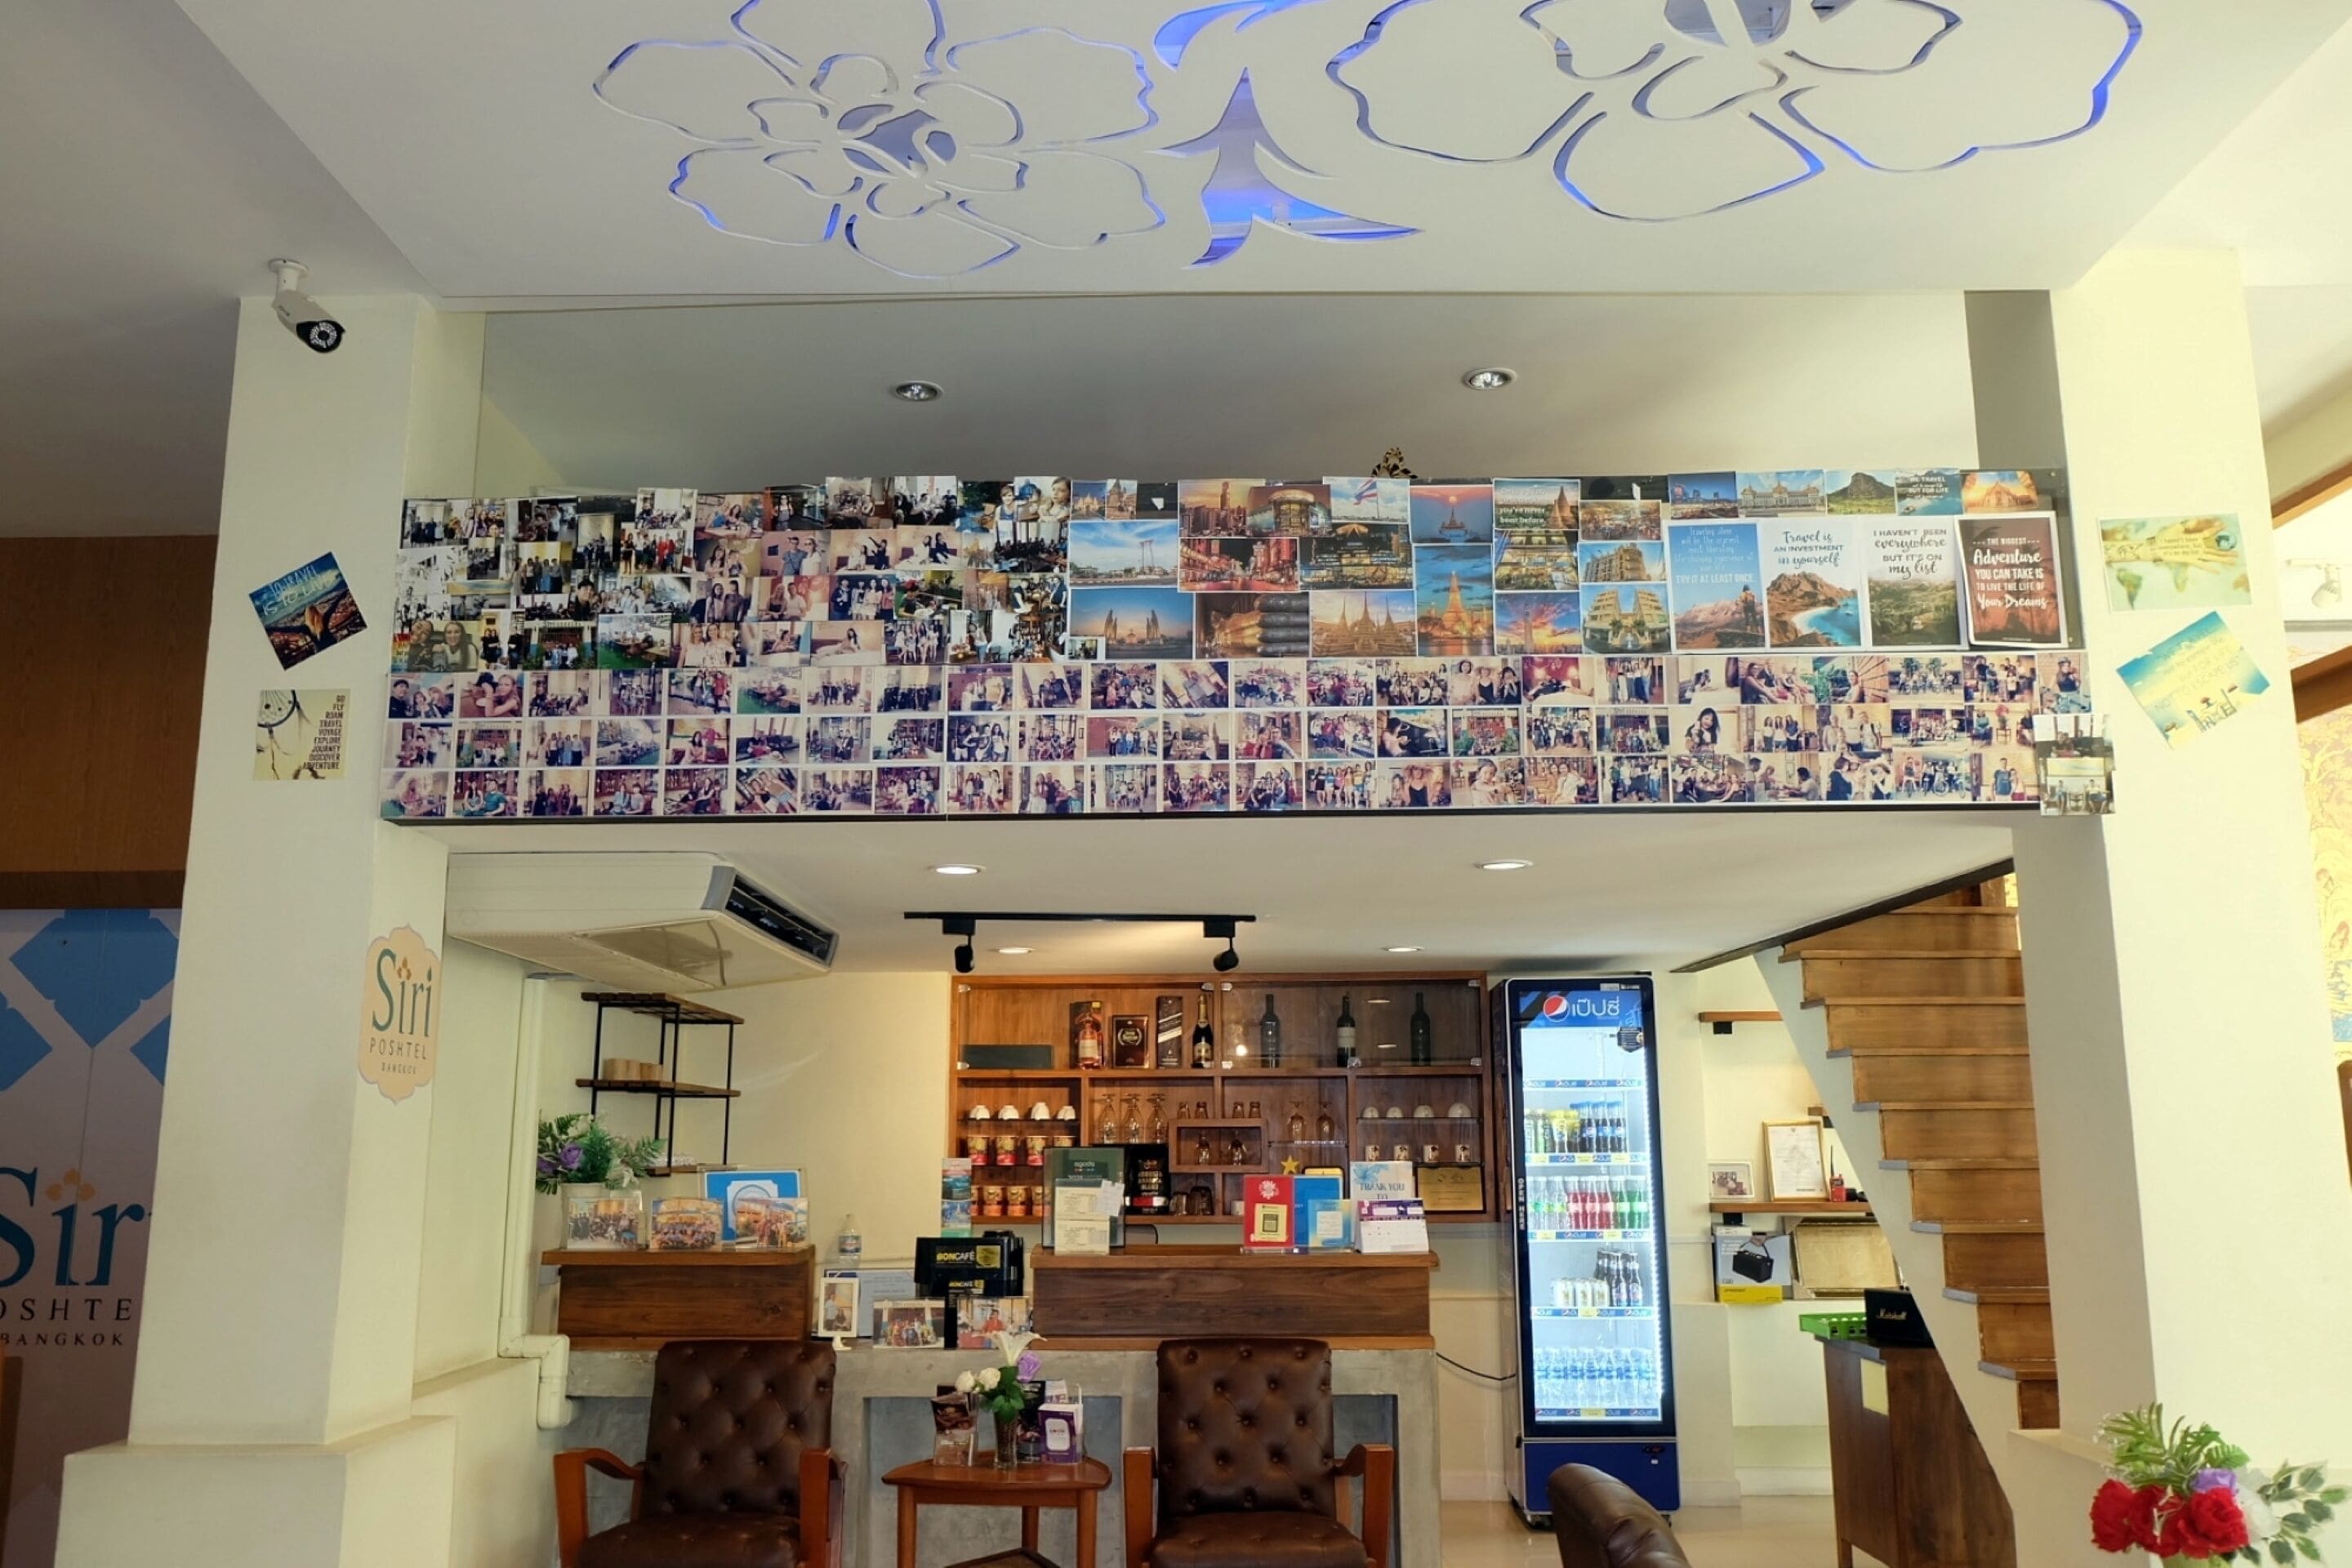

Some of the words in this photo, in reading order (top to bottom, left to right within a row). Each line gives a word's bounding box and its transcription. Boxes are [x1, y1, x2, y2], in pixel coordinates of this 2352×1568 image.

[1782, 530, 1820, 543] Travel
[1824, 533, 1832, 543] is
[1874, 536, 1947, 553] everywhere
[1793, 552, 1841, 569] yourself
[1973, 549, 2042, 565] Adventure
[283, 564, 318, 586] TRAVEL
[1889, 565, 1911, 580] my
[1914, 559, 1937, 574] list
[1975, 569, 1992, 580] YOU
[1993, 569, 2011, 580] CAN
[2012, 568, 2034, 579] TAKE
[2036, 568, 2044, 579] IS
[1976, 582, 1985, 590] TO
[1987, 582, 2002, 590] LIVE
[2005, 582, 2018, 590] THE
[2019, 582, 2034, 590] LIFE
[2037, 581, 2045, 590] OF
[262, 601, 278, 615] IS
[283, 592, 299, 607] TO
[1977, 593, 2002, 610] Your
[2005, 594, 2047, 610] Dreams
[372, 948, 432, 1037] Siri
[1571, 995, 1619, 1017] เป๊ปซี่
[369, 1037, 427, 1060] POSHTEL
[381, 1062, 416, 1075] BANGKOK
[1360, 1183, 1388, 1192] THANK
[1388, 1183, 1405, 1192] YOU
[0, 1166, 152, 1288] Sir
[936, 1250, 975, 1262] BONCAFÉ
